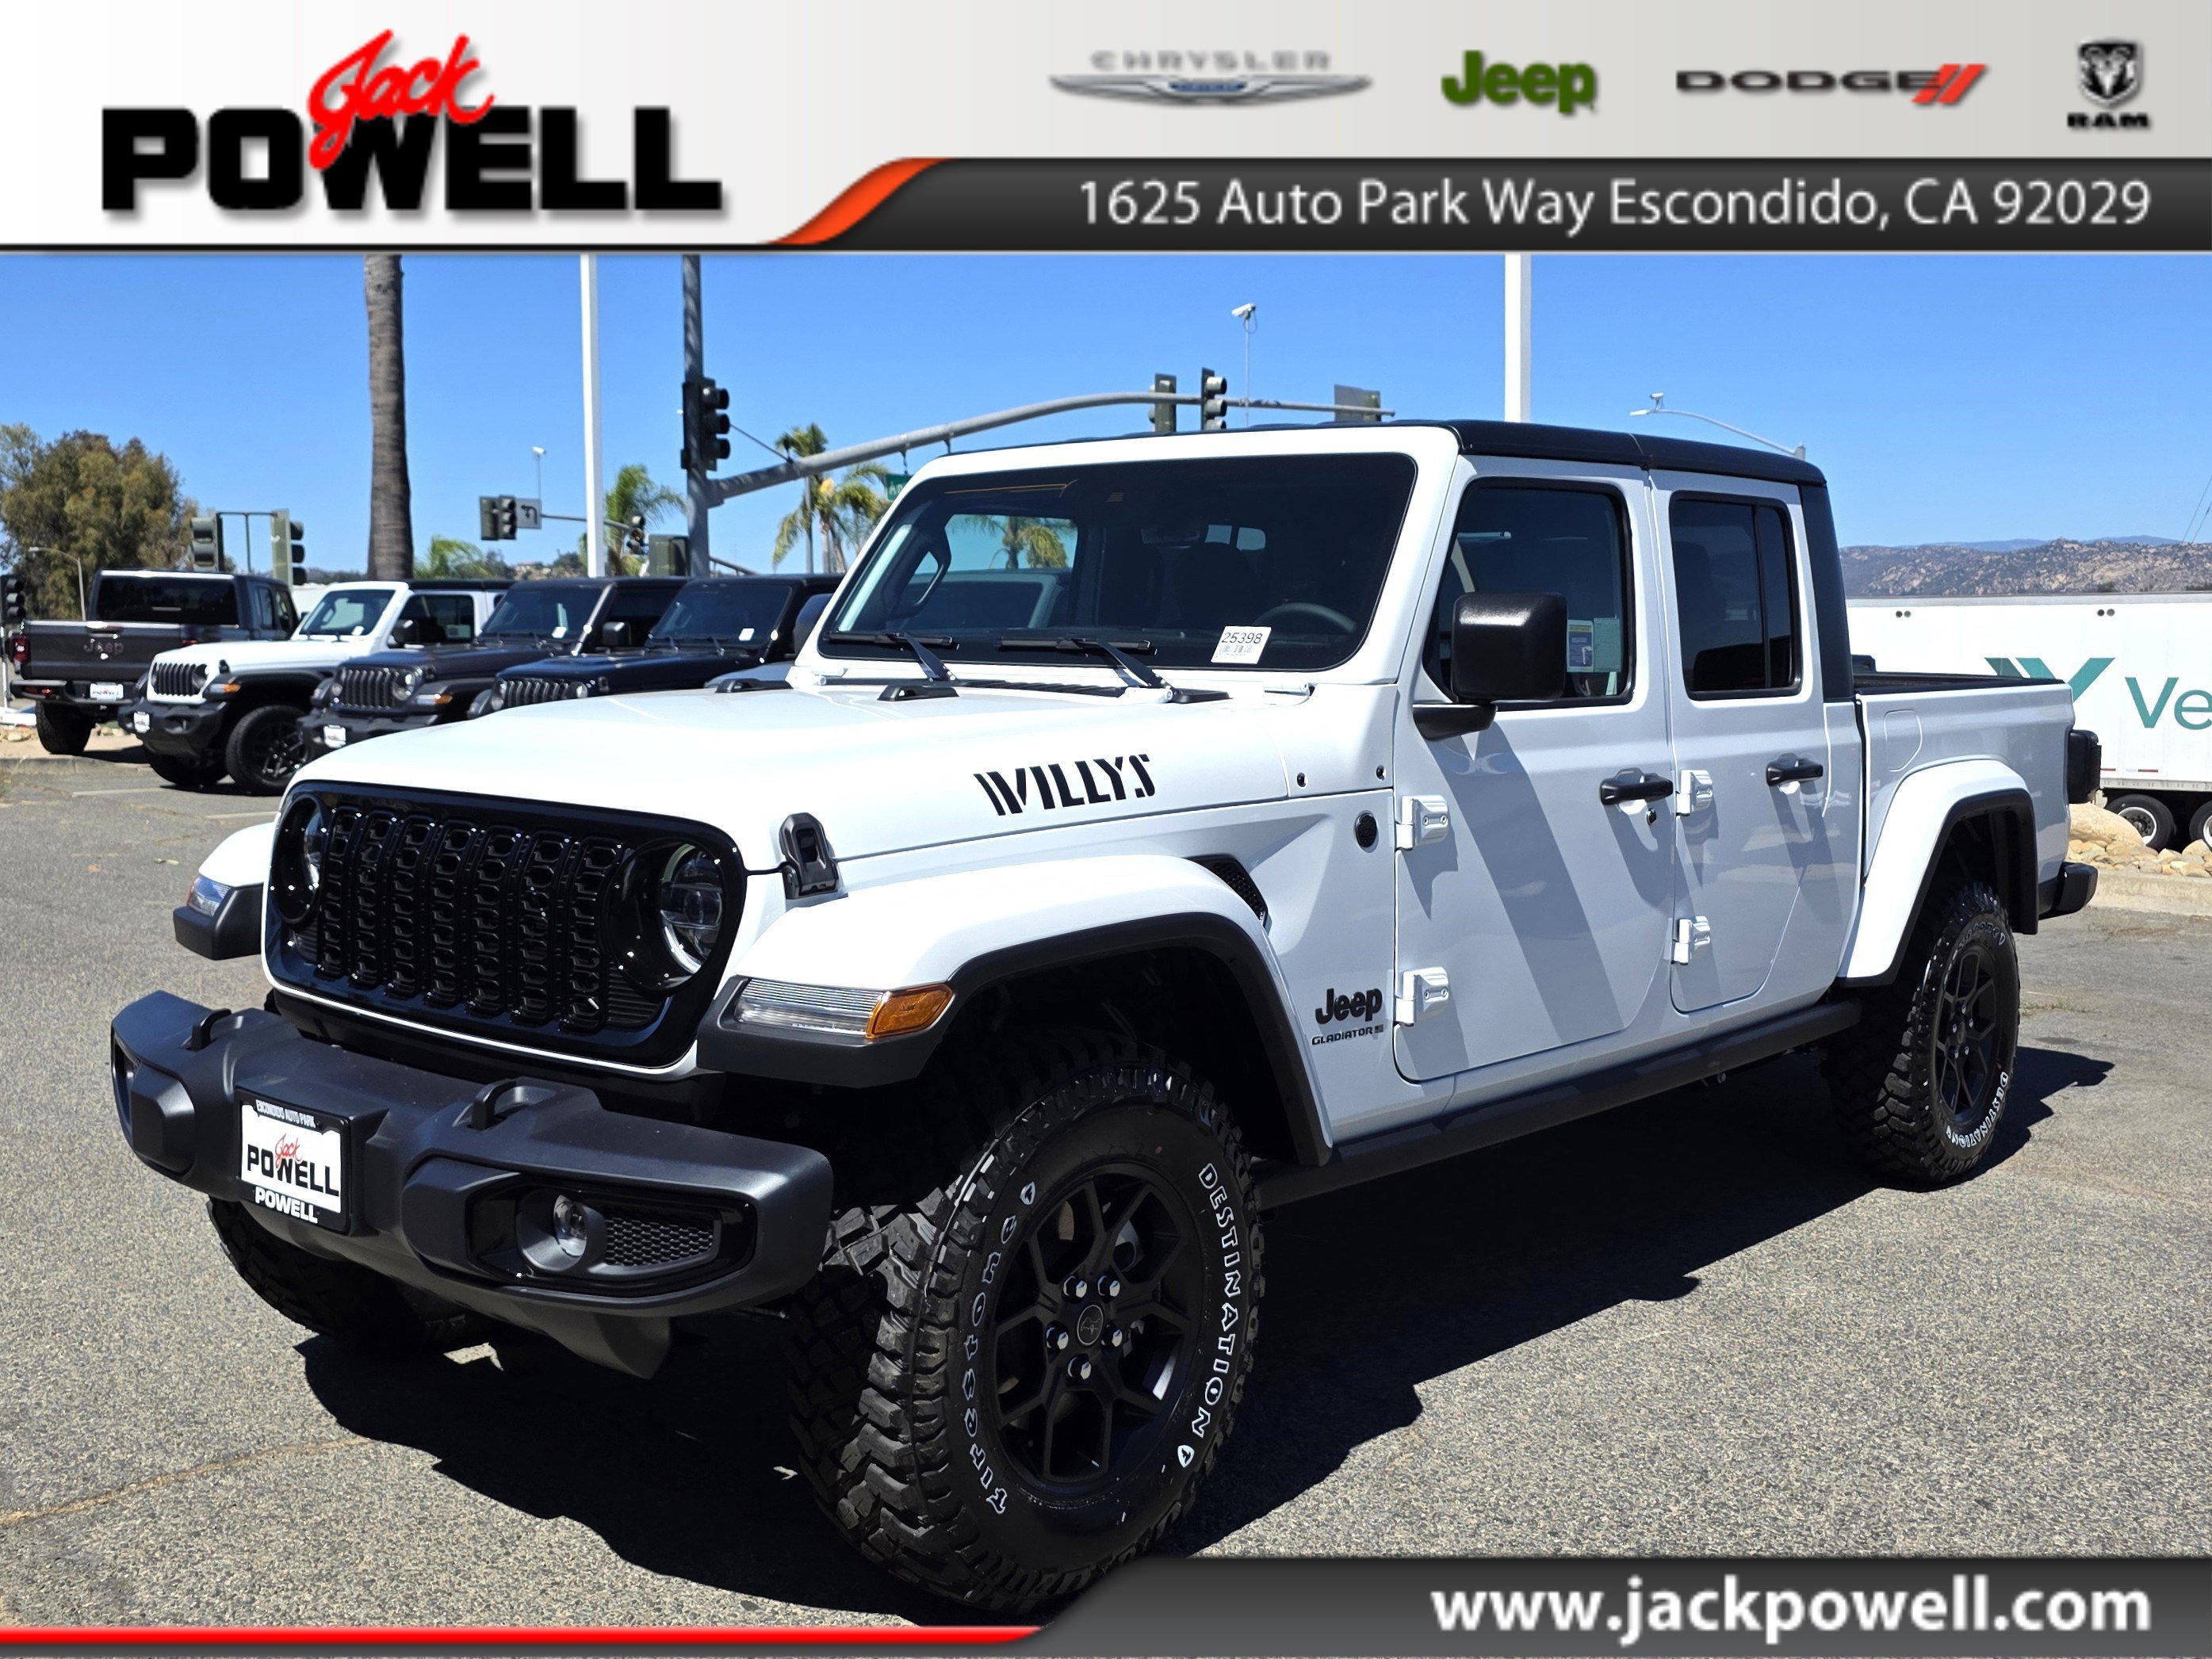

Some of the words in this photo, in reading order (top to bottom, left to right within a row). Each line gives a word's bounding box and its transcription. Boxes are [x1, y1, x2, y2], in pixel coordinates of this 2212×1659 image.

[1221, 632, 1263, 644] 25398
[2125, 676, 2212, 730] Ve
[973, 754, 1156, 816] WILLYS
[1315, 988, 1383, 1024] Jeep
[1311, 1026, 1373, 1045] GLADIATOR
[1951, 1071, 2009, 1149] DESTINATION
[247, 1144, 340, 1198] POWELL
[274, 1133, 303, 1169] Jack
[254, 1186, 319, 1224] POWELL
[1192, 1162, 1242, 1439] DESTINATION
